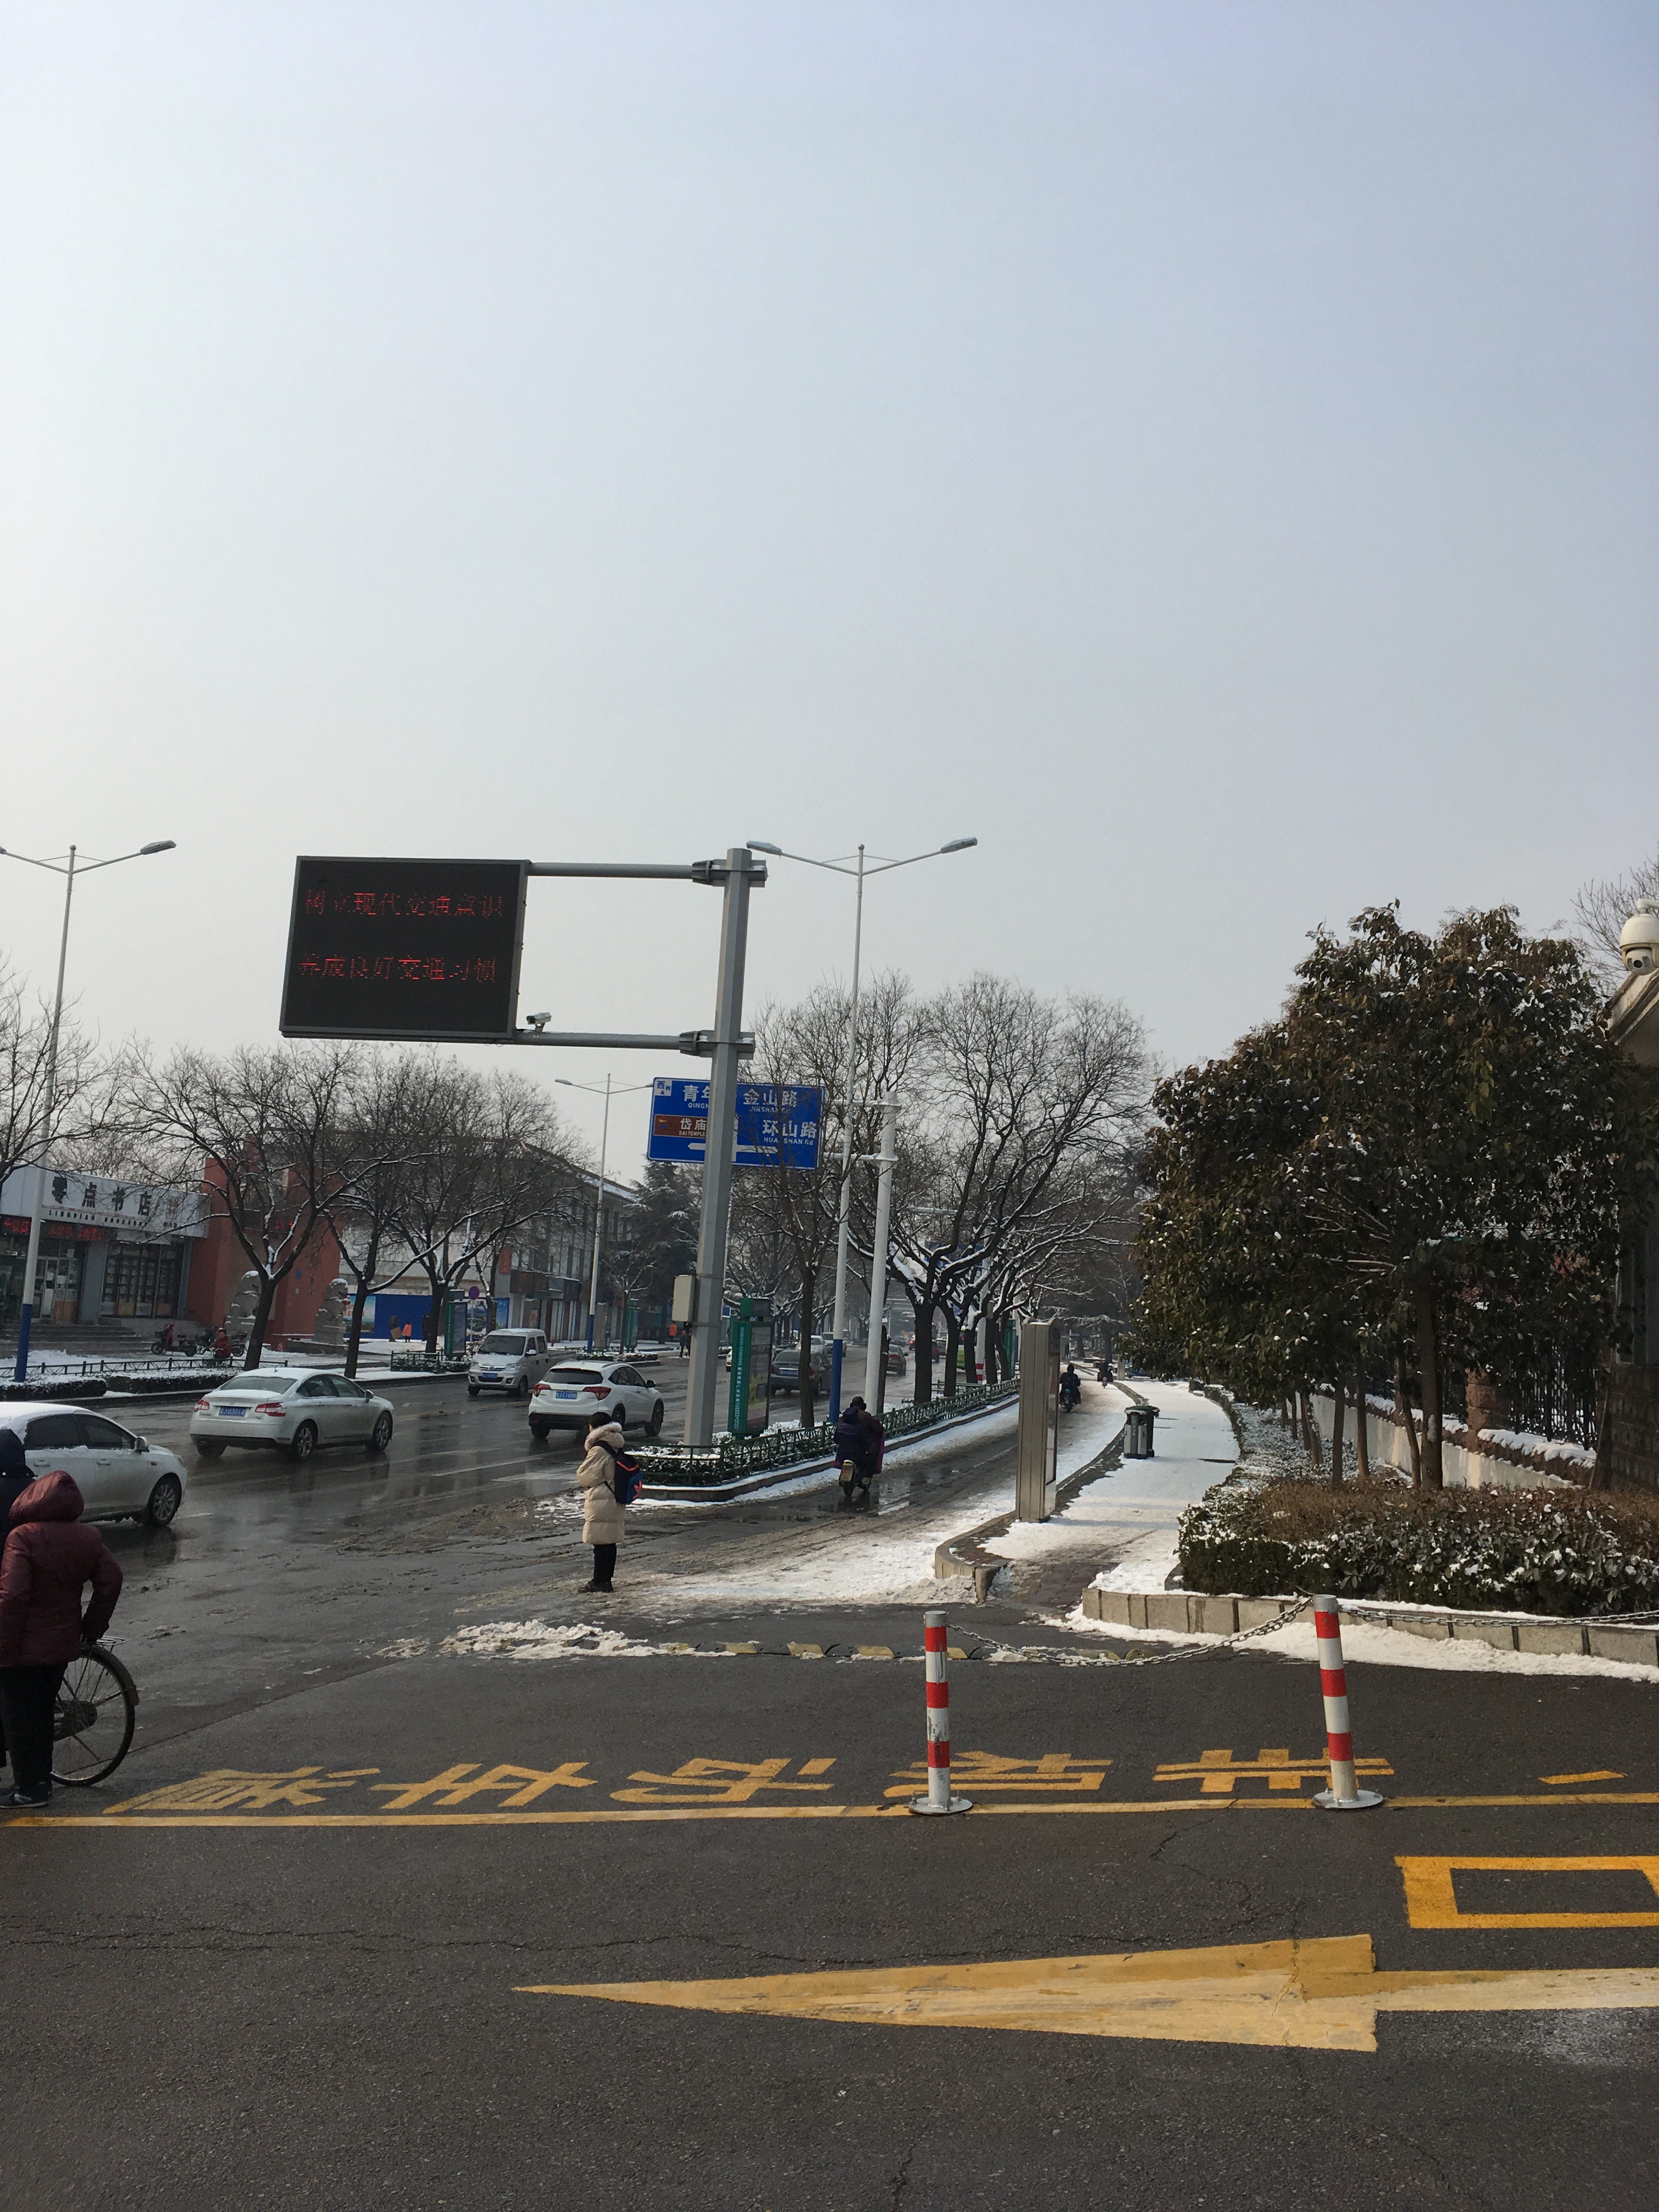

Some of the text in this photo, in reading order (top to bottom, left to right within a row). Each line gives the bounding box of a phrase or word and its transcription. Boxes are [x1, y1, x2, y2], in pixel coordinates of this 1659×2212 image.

[657, 1081, 665, 1089] 西
[743, 1088, 798, 1108] 金山路
[680, 1118, 707, 1131] 岱庙
[763, 1119, 817, 1139] 环山路
[763, 1137, 803, 1145] HUASHAN
